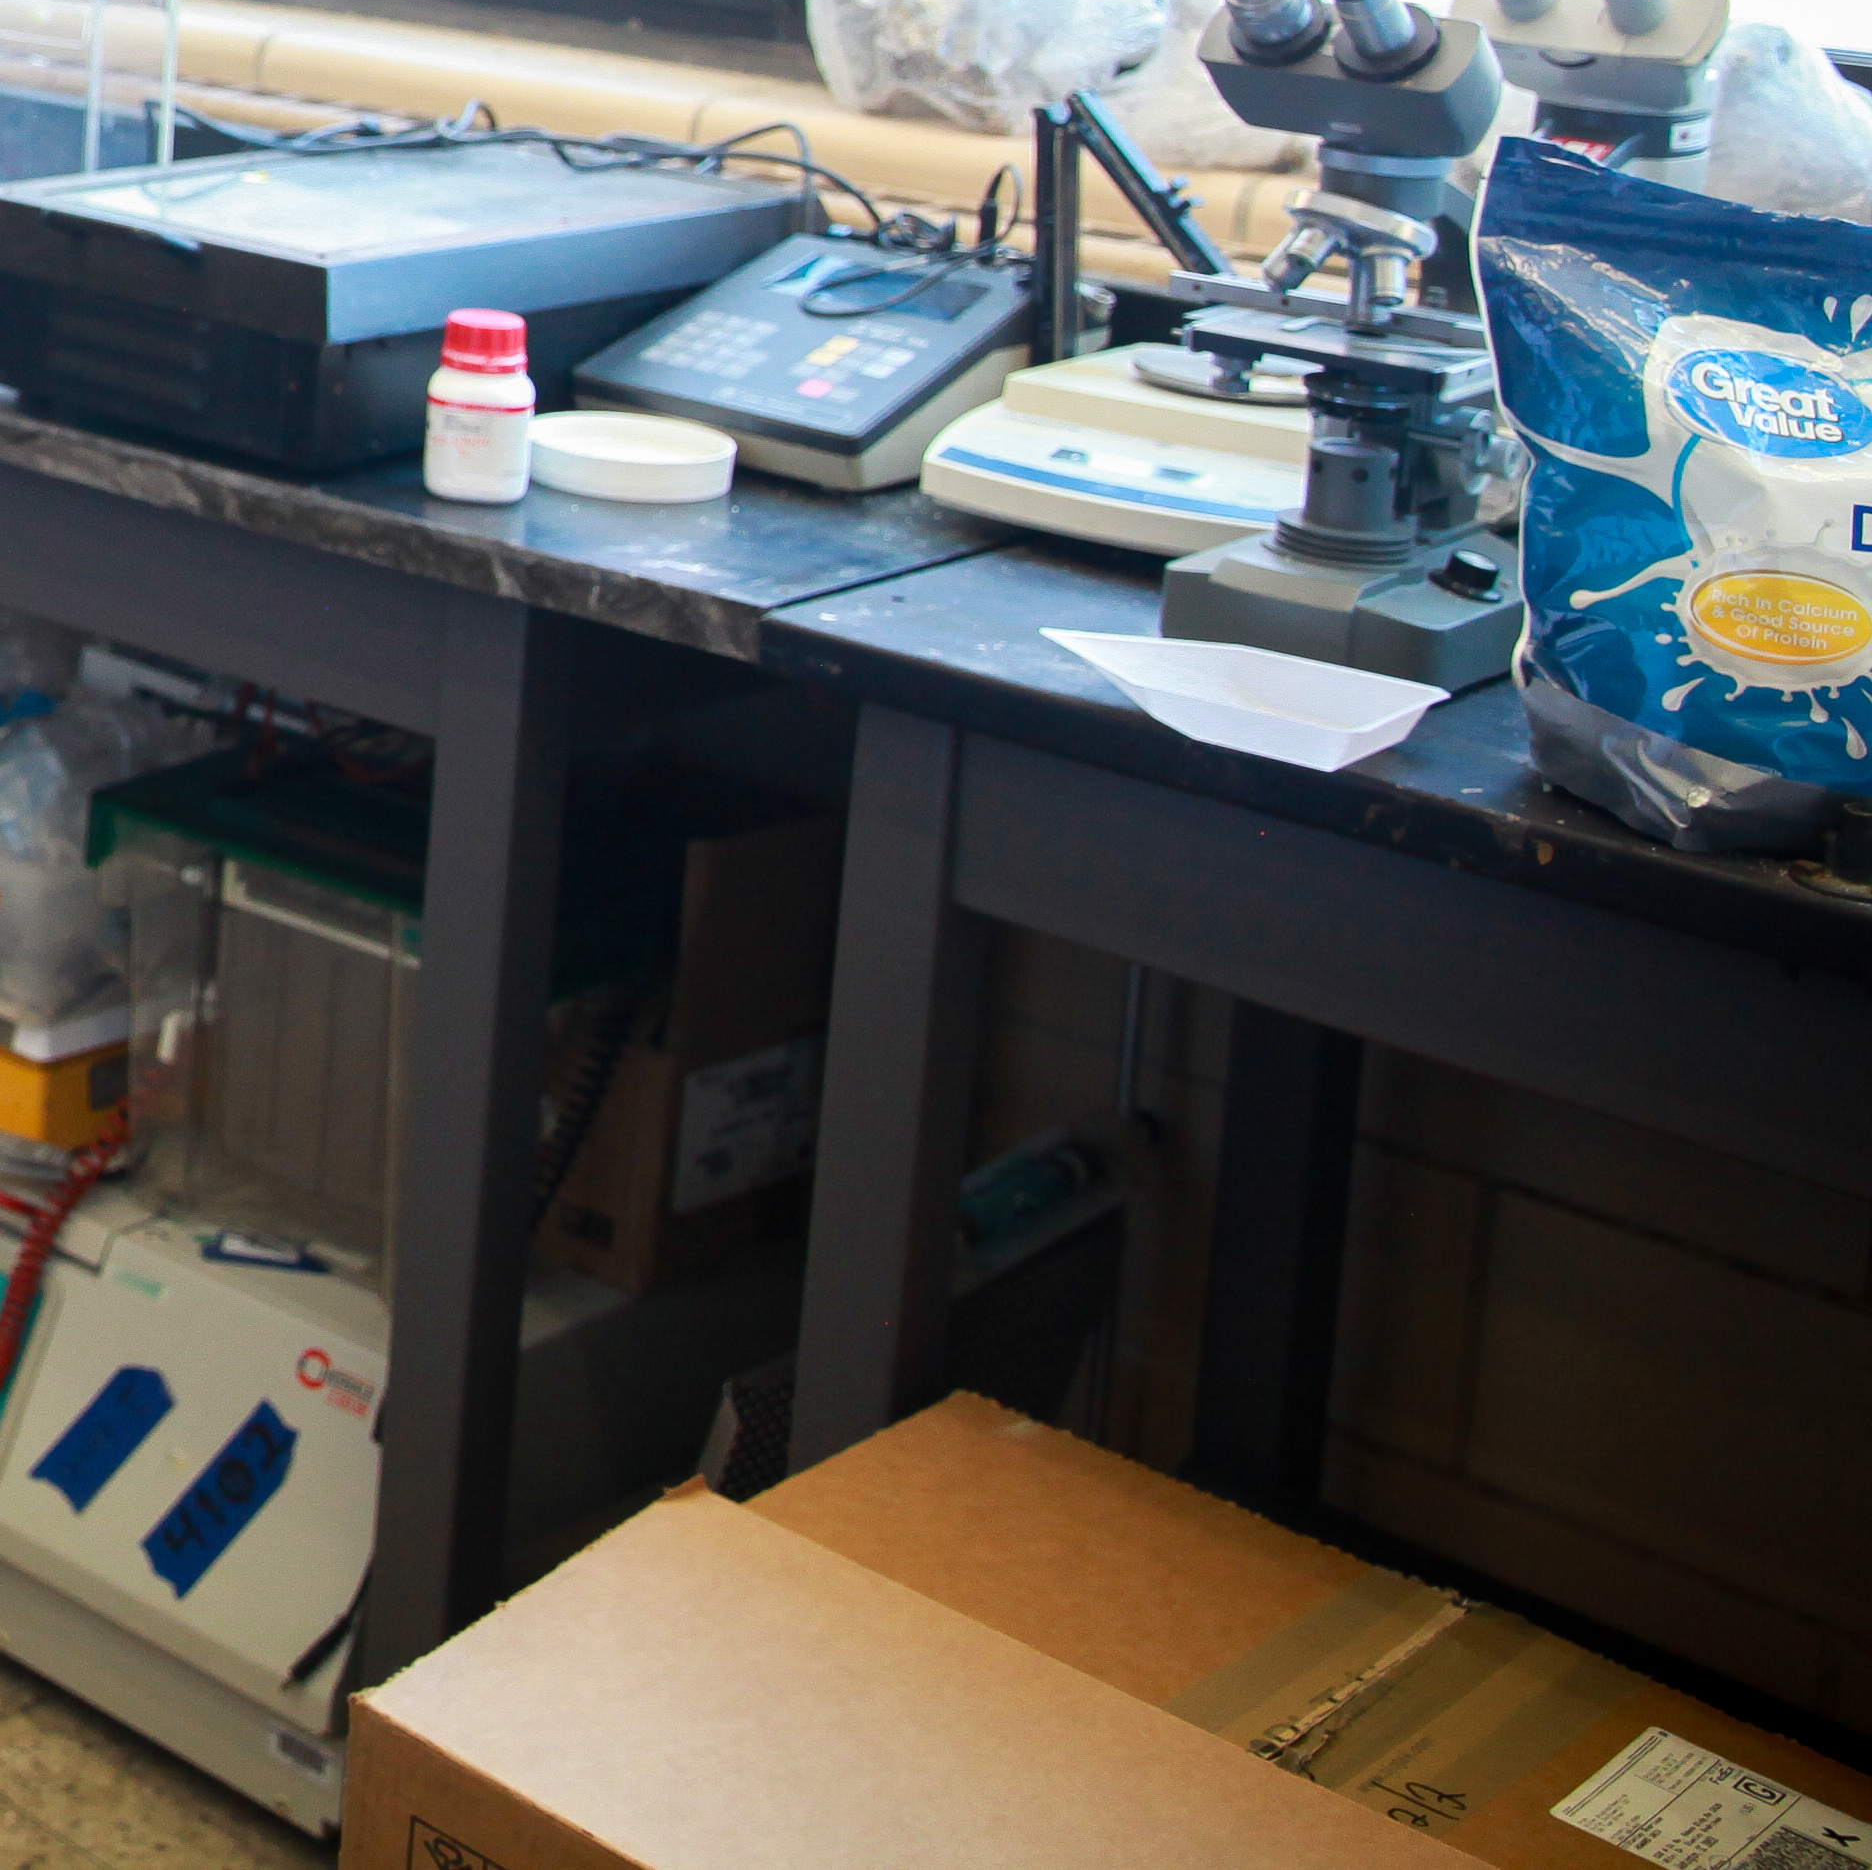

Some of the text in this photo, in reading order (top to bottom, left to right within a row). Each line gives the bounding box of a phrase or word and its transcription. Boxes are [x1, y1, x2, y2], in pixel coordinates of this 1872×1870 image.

[1691, 361, 1845, 443] Great Value
[1712, 589, 1750, 608] Rich
[1778, 599, 1858, 621] Calcium
[1730, 608, 1784, 629] Good
[1789, 616, 1855, 638] Source
[1764, 630, 1828, 651] Protein
